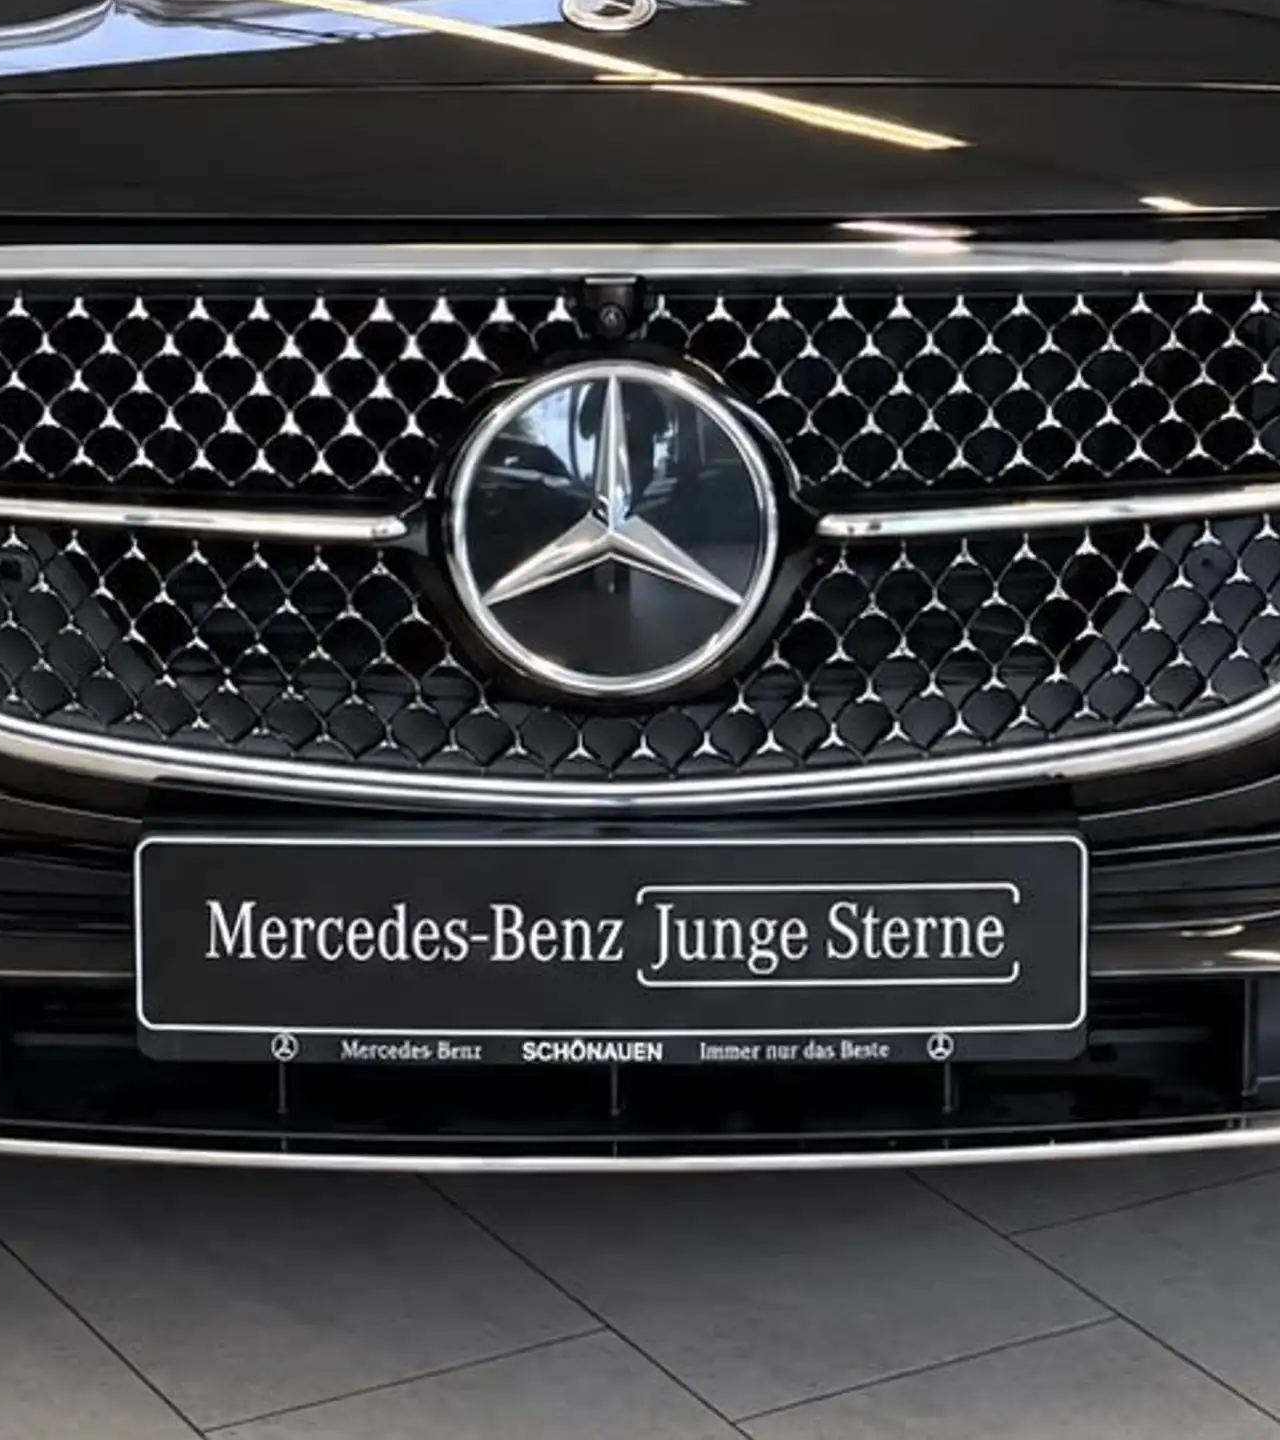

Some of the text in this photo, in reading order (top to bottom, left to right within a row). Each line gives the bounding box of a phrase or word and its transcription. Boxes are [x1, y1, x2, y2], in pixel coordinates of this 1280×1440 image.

[205, 899, 1006, 973] Mercedes-Benz Junge Sterne
[521, 1038, 664, 1062] SCHÖNAUEN
[699, 1041, 761, 1061] Immer
[765, 1043, 798, 1060] nur
[803, 1039, 835, 1060] das
[840, 1040, 891, 1059] Beste
